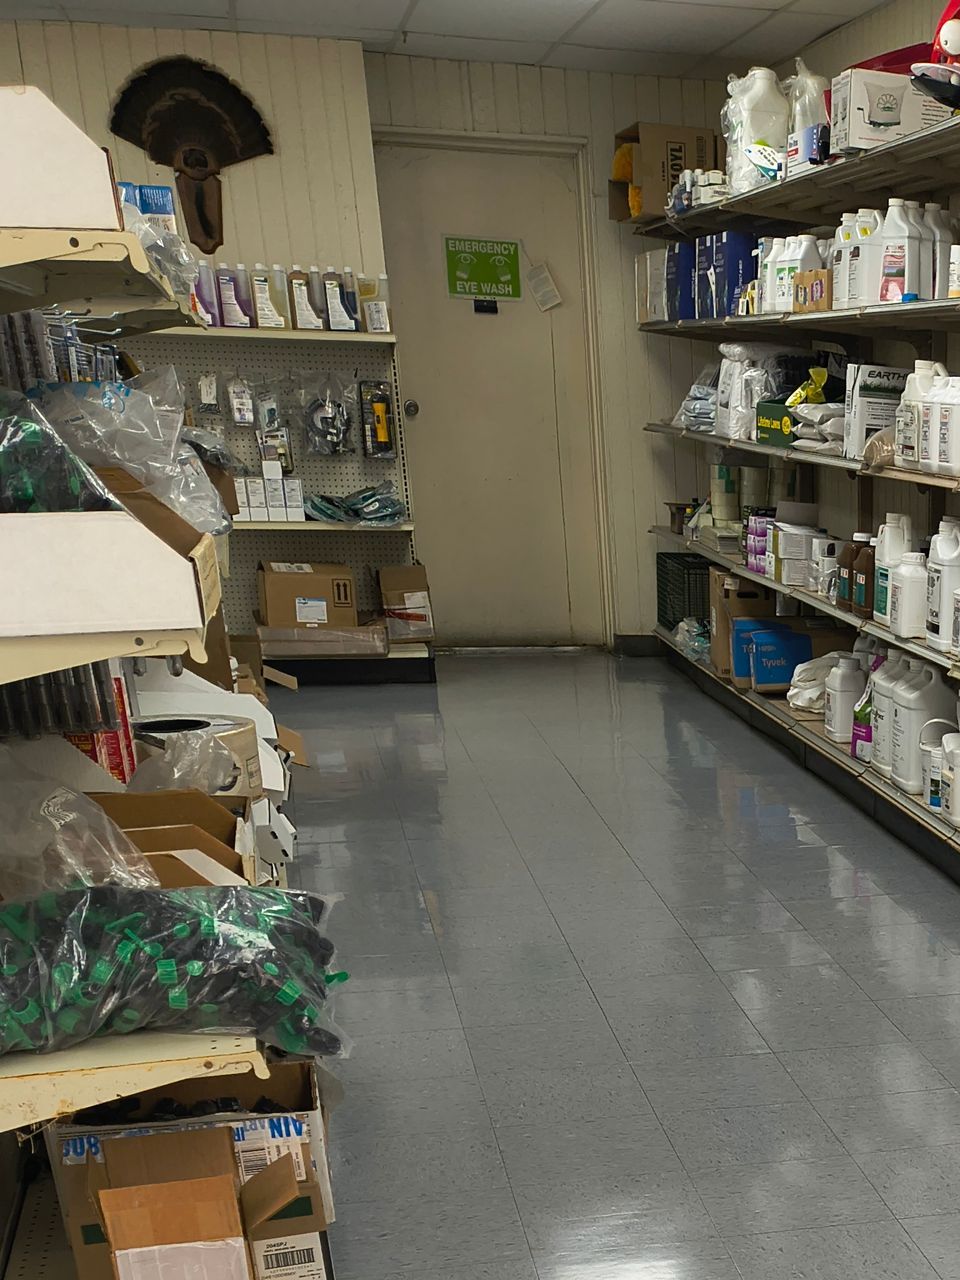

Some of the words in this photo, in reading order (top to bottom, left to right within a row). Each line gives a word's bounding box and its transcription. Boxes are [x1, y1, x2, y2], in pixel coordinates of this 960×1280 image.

[448, 240, 516, 255] EMERGENCY
[456, 281, 478, 293] EYE
[480, 282, 513, 295] WASH
[761, 657, 786, 669] Tyvek
